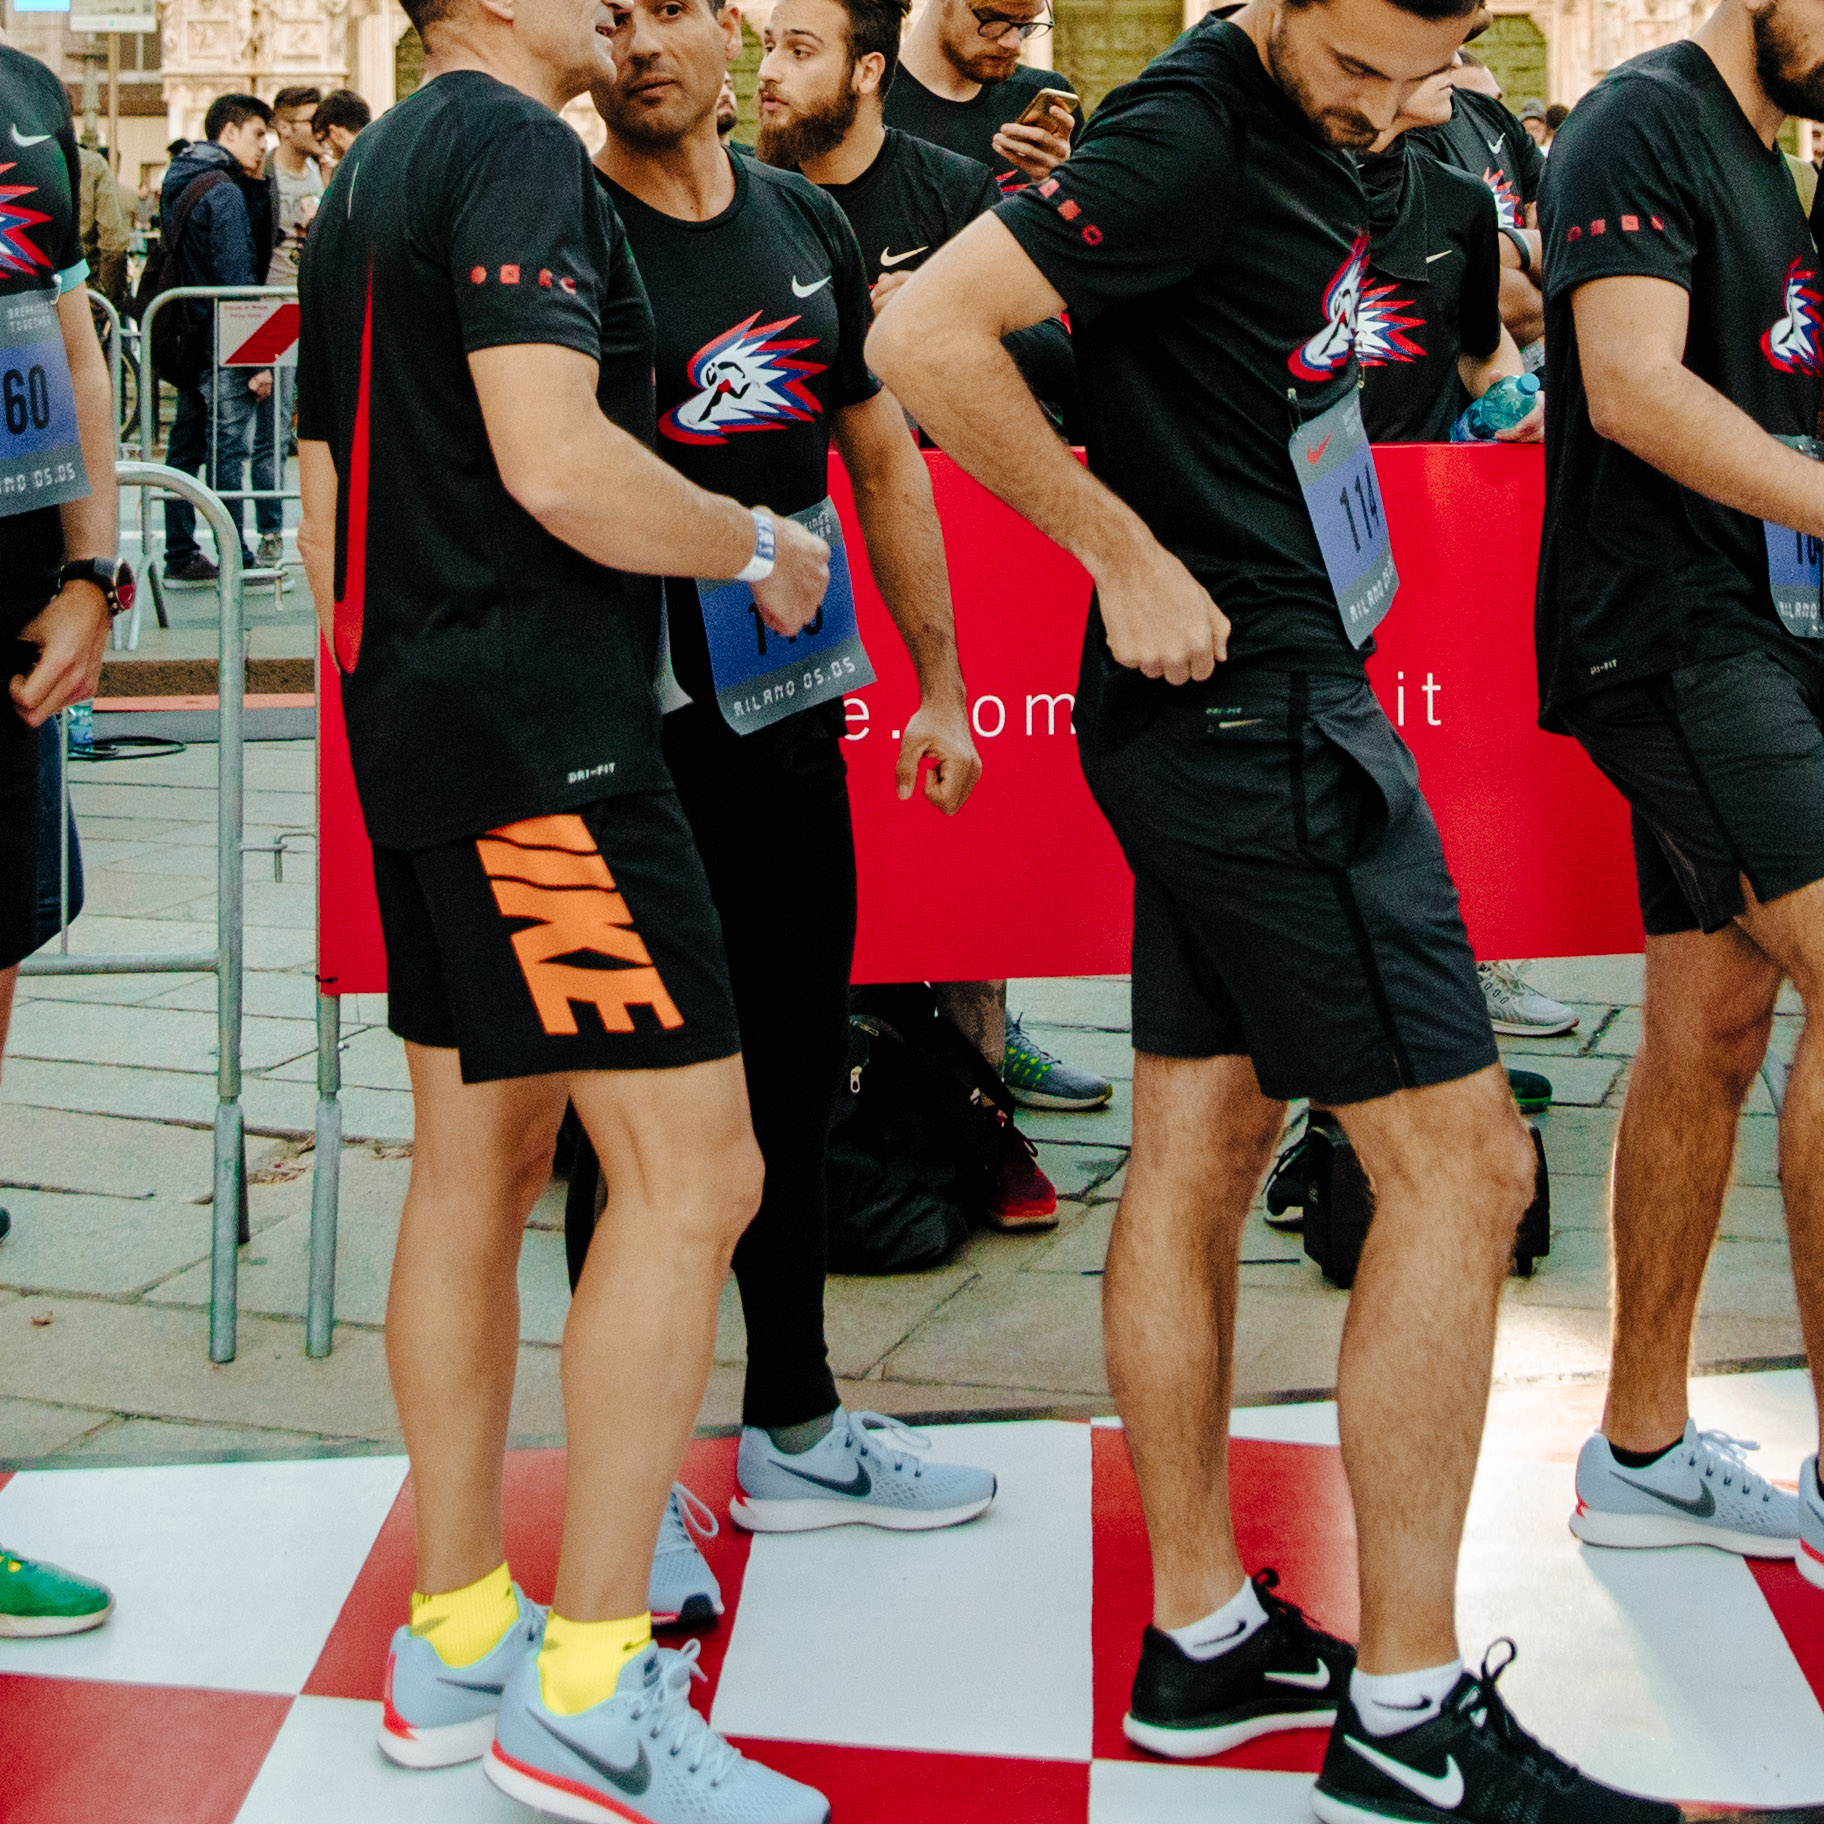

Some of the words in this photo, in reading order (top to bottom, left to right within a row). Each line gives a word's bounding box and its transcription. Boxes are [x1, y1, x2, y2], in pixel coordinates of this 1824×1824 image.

[34, 462, 76, 489] 05.05
[733, 680, 795, 718] MILANO
[803, 656, 856, 690] 05.05
[567, 762, 617, 784] DRI-FIT
